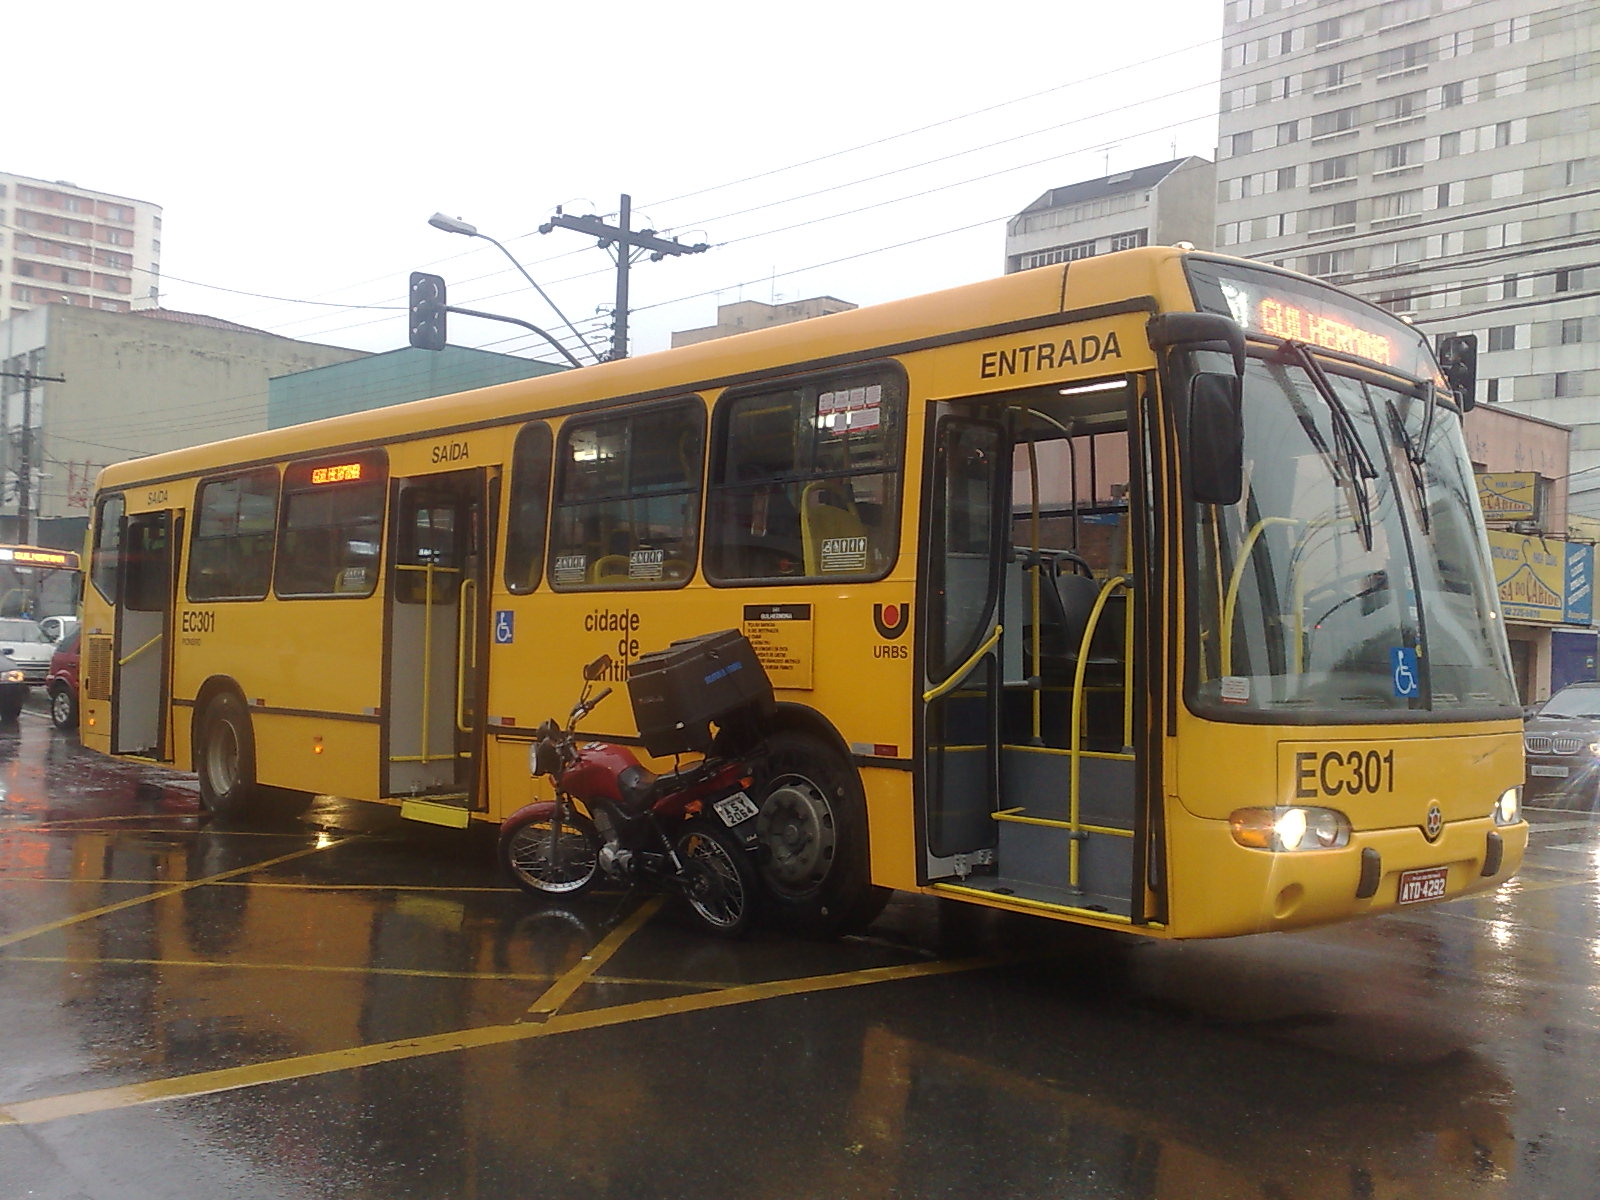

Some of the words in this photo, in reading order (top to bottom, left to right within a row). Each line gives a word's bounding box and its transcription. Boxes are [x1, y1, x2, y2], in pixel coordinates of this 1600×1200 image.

[980, 331, 1122, 379] ENTRADA
[431, 440, 469, 464] SAÍDA
[182, 611, 215, 632] EC301
[584, 609, 640, 632] cidade
[618, 638, 640, 657] de
[873, 645, 908, 659] URBS
[1296, 749, 1394, 799] EC301
[1402, 878, 1446, 901] ATD-4292
